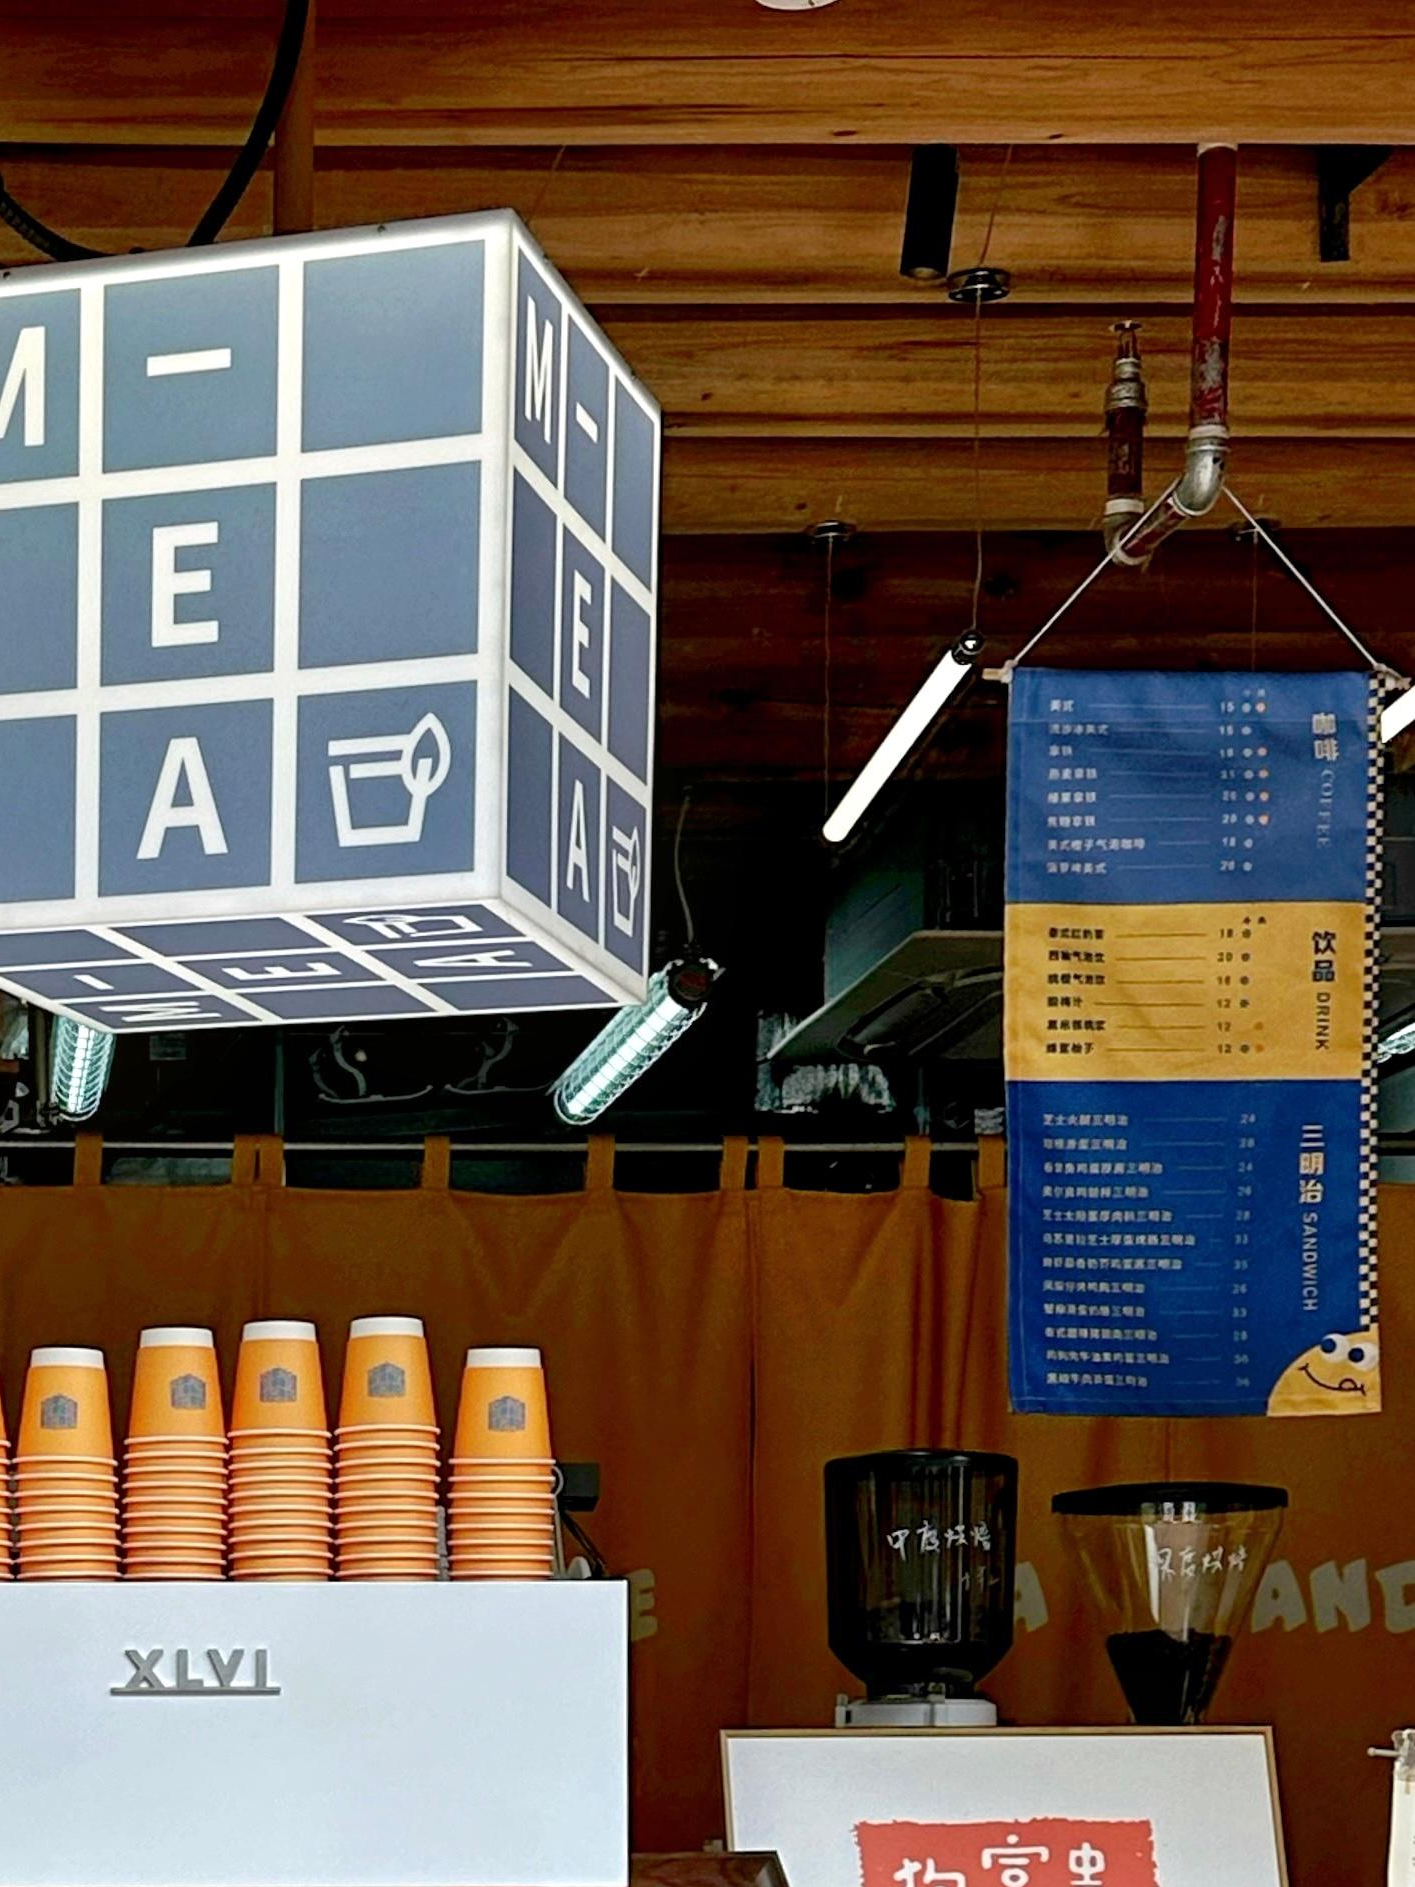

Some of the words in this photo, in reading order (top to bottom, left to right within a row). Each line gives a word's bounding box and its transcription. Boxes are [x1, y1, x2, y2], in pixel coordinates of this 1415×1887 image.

[151, 521, 219, 648] E
[136, 737, 229, 861] A
[1311, 930, 1337, 983] 饮品
[1315, 991, 1331, 1050] DRINK
[1299, 1124, 1325, 1204] 三明治
[1303, 1212, 1319, 1311] SANDWICH
[123, 1648, 269, 1690] XLVI
